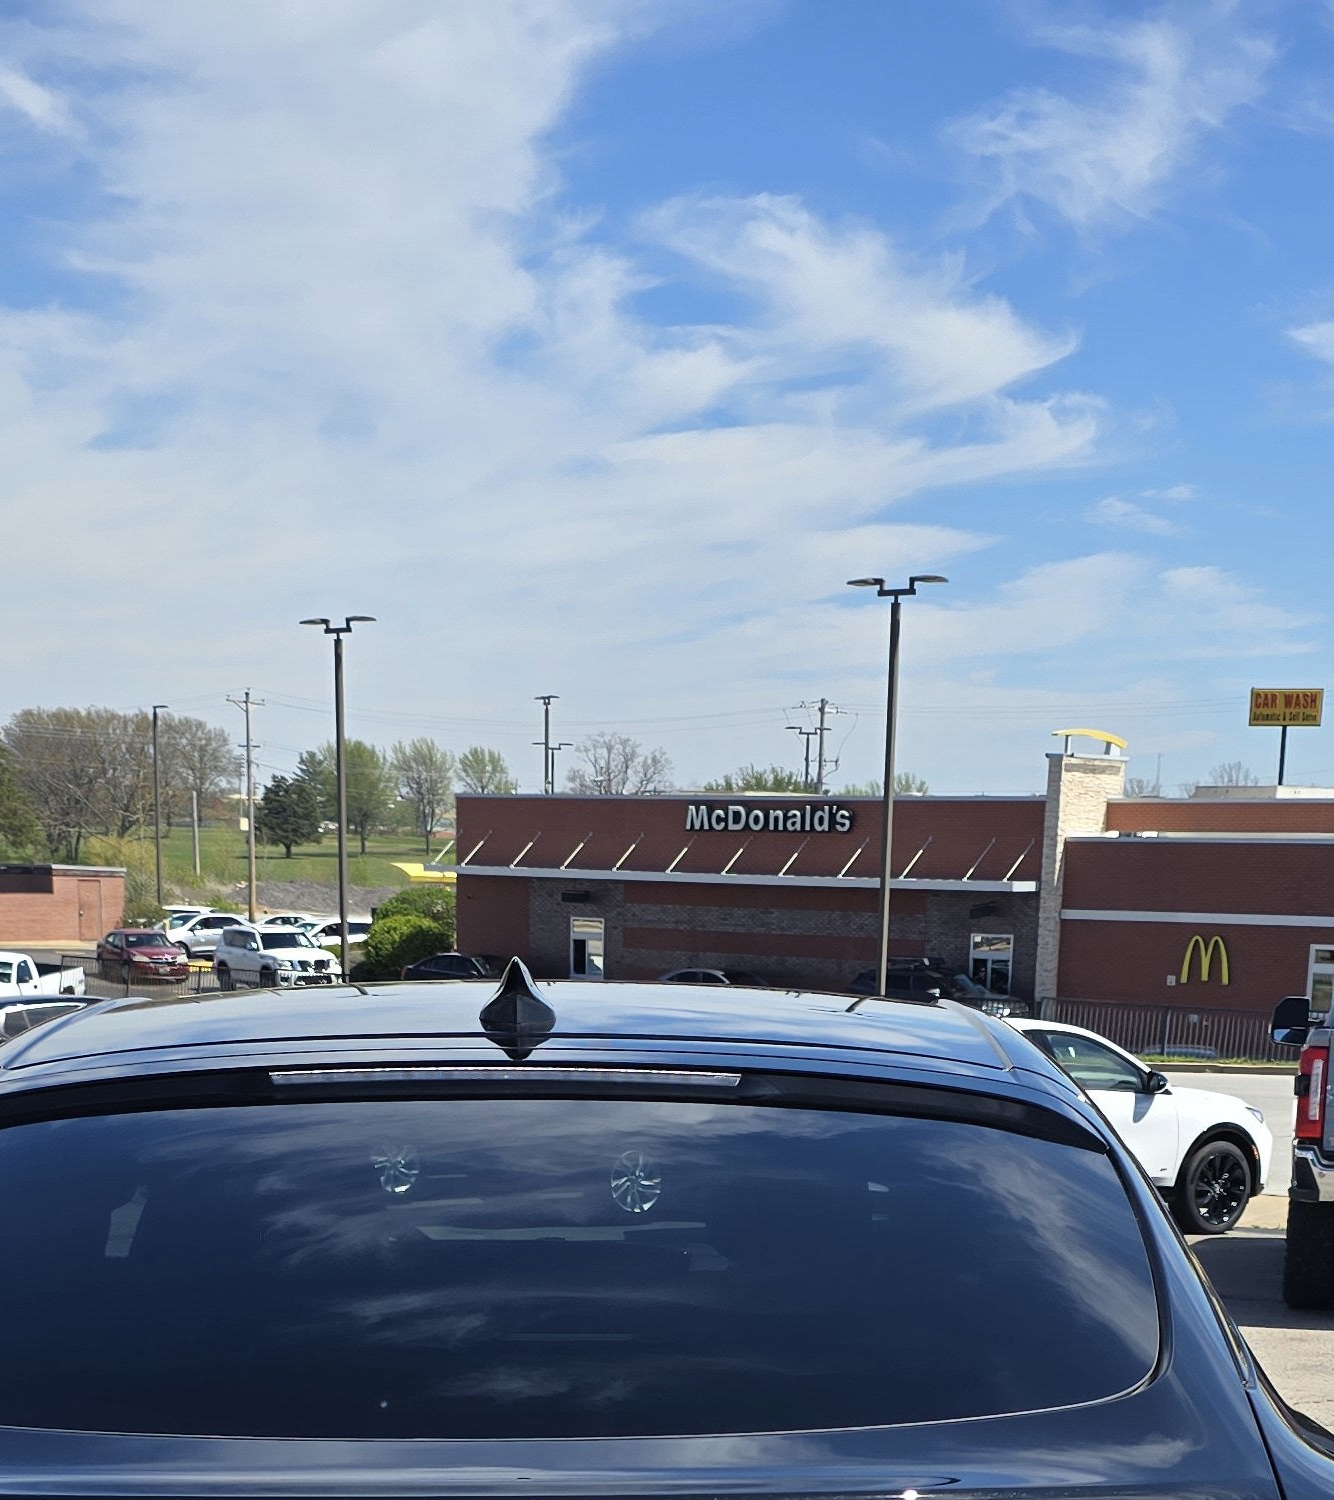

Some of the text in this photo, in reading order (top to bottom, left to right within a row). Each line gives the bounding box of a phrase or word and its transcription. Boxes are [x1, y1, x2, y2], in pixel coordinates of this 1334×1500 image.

[1255, 693, 1318, 709] CAR WASH
[685, 805, 851, 832] McDonald's
